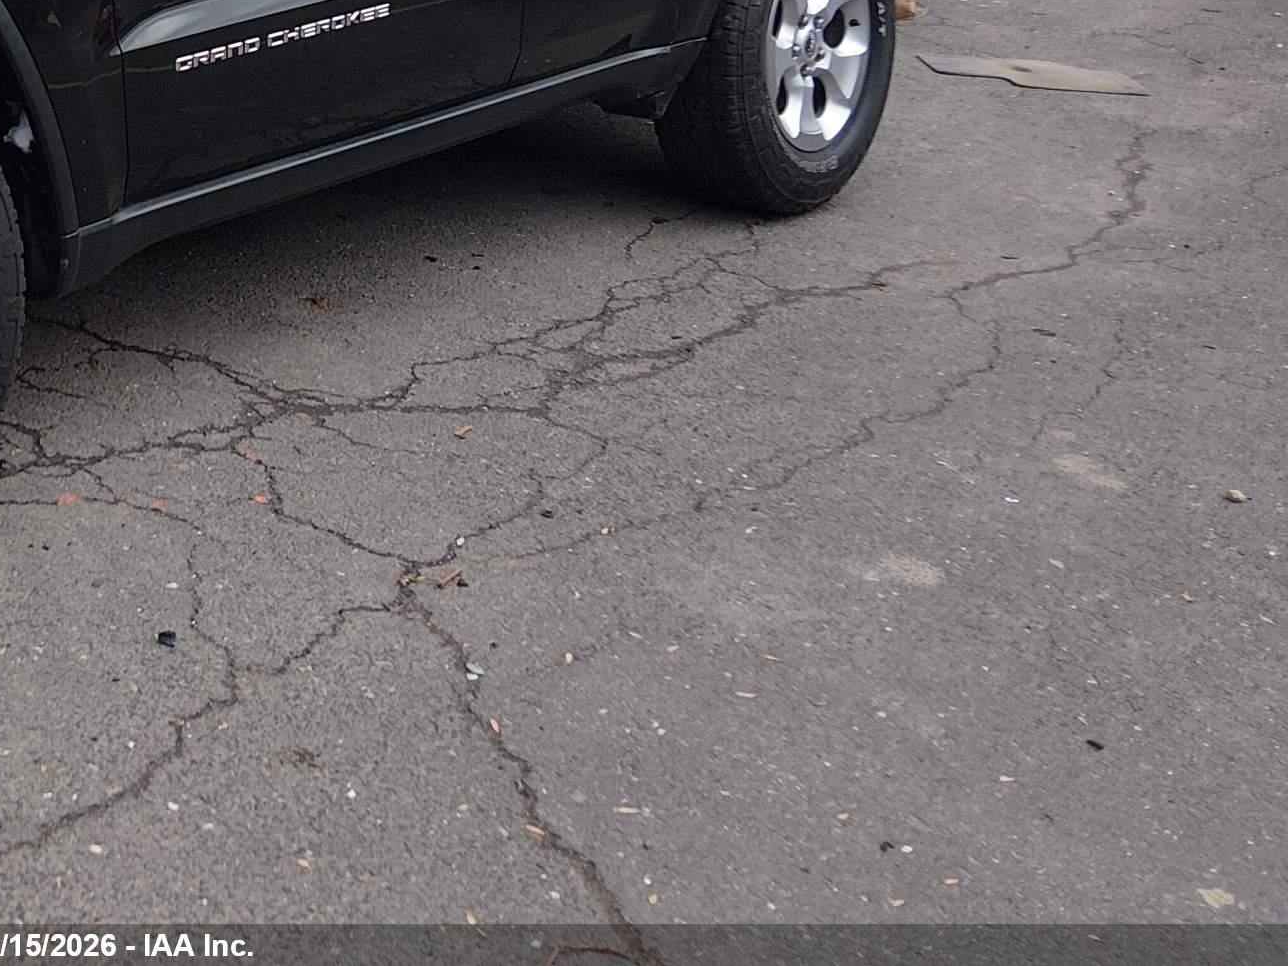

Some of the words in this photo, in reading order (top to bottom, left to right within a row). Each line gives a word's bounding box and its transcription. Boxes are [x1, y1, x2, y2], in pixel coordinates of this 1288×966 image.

[175, 36, 261, 73] GRAND
[267, 2, 391, 48] CHEROKEE
[876, 1, 887, 37] A/T
